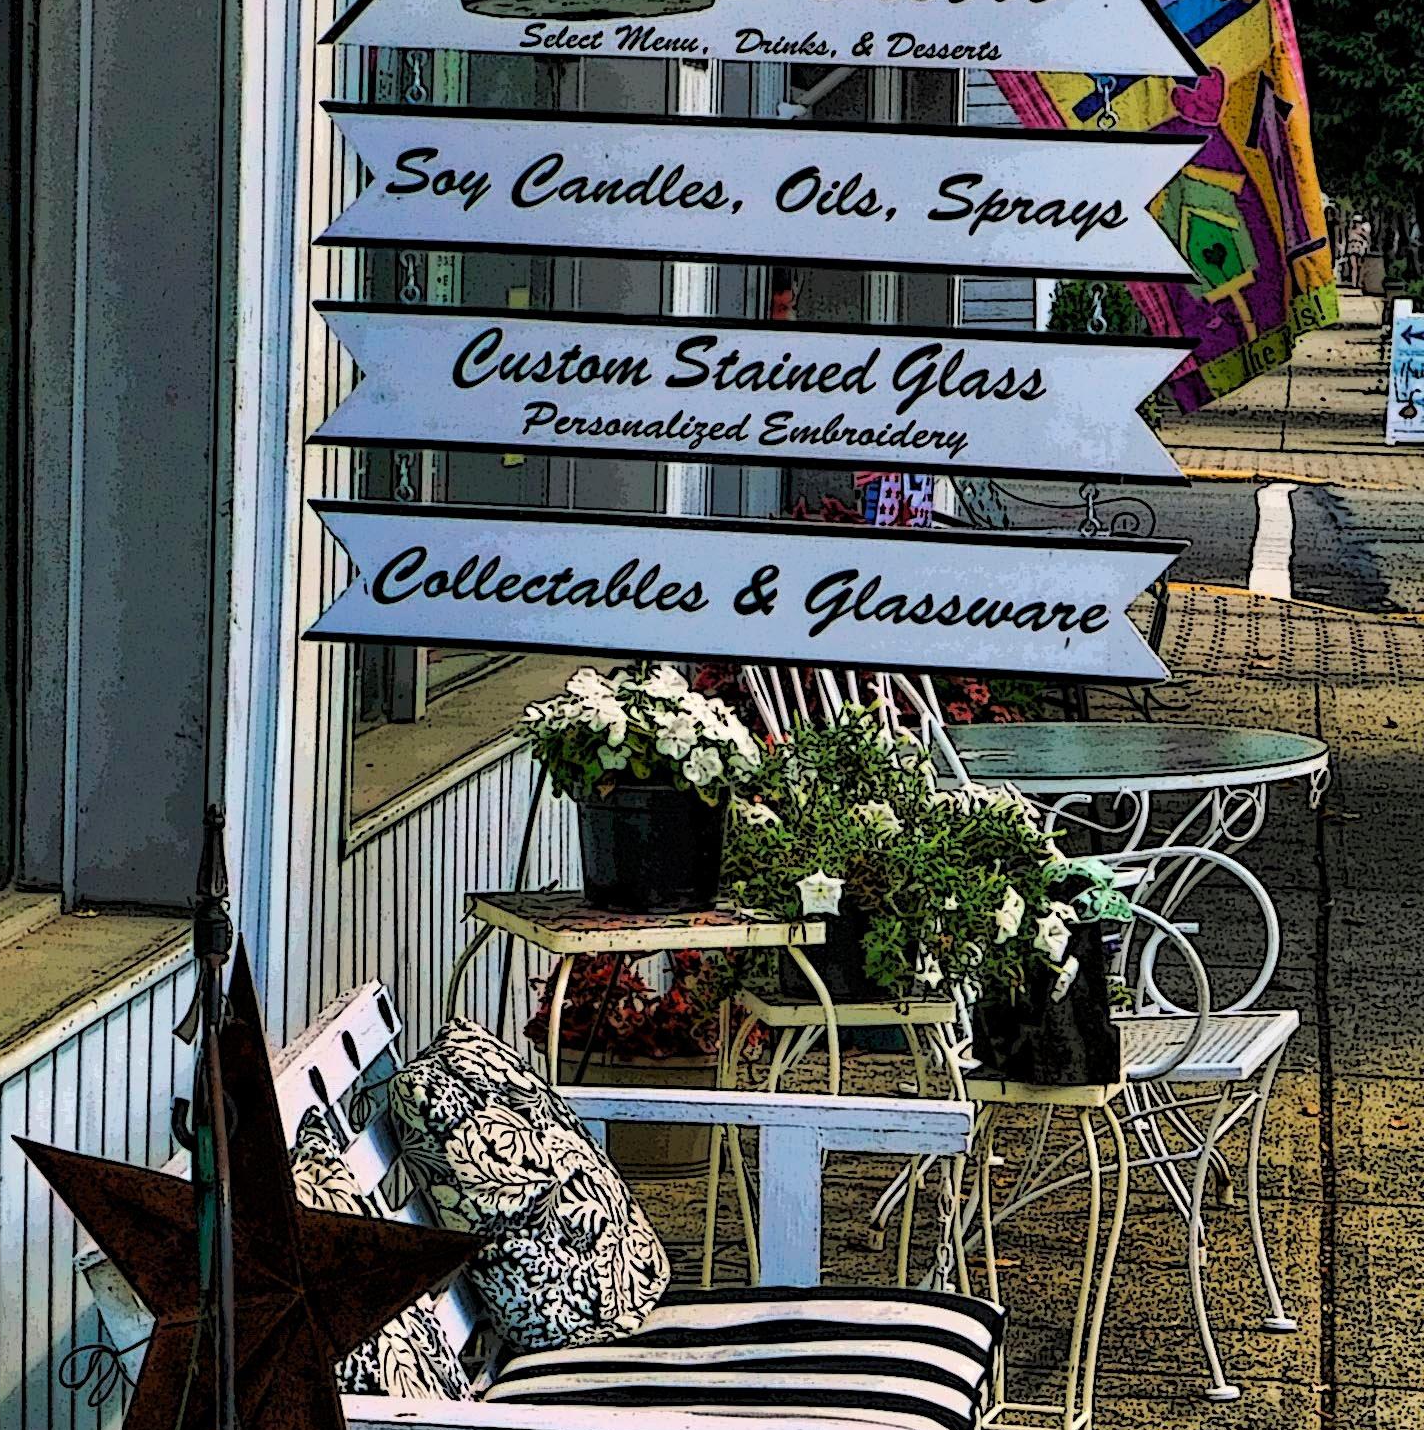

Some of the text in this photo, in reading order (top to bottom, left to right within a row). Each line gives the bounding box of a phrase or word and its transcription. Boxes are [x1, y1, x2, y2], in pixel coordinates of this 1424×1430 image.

[519, 22, 1002, 62] Select Menu, Drinks, & Desserts
[386, 148, 1129, 242] Soy Candles, Oils, Sprays
[452, 328, 1049, 415] Custom Stained Glass
[522, 402, 969, 461] Personalized Embroidery
[372, 547, 1110, 638] Collectables & Glassware
